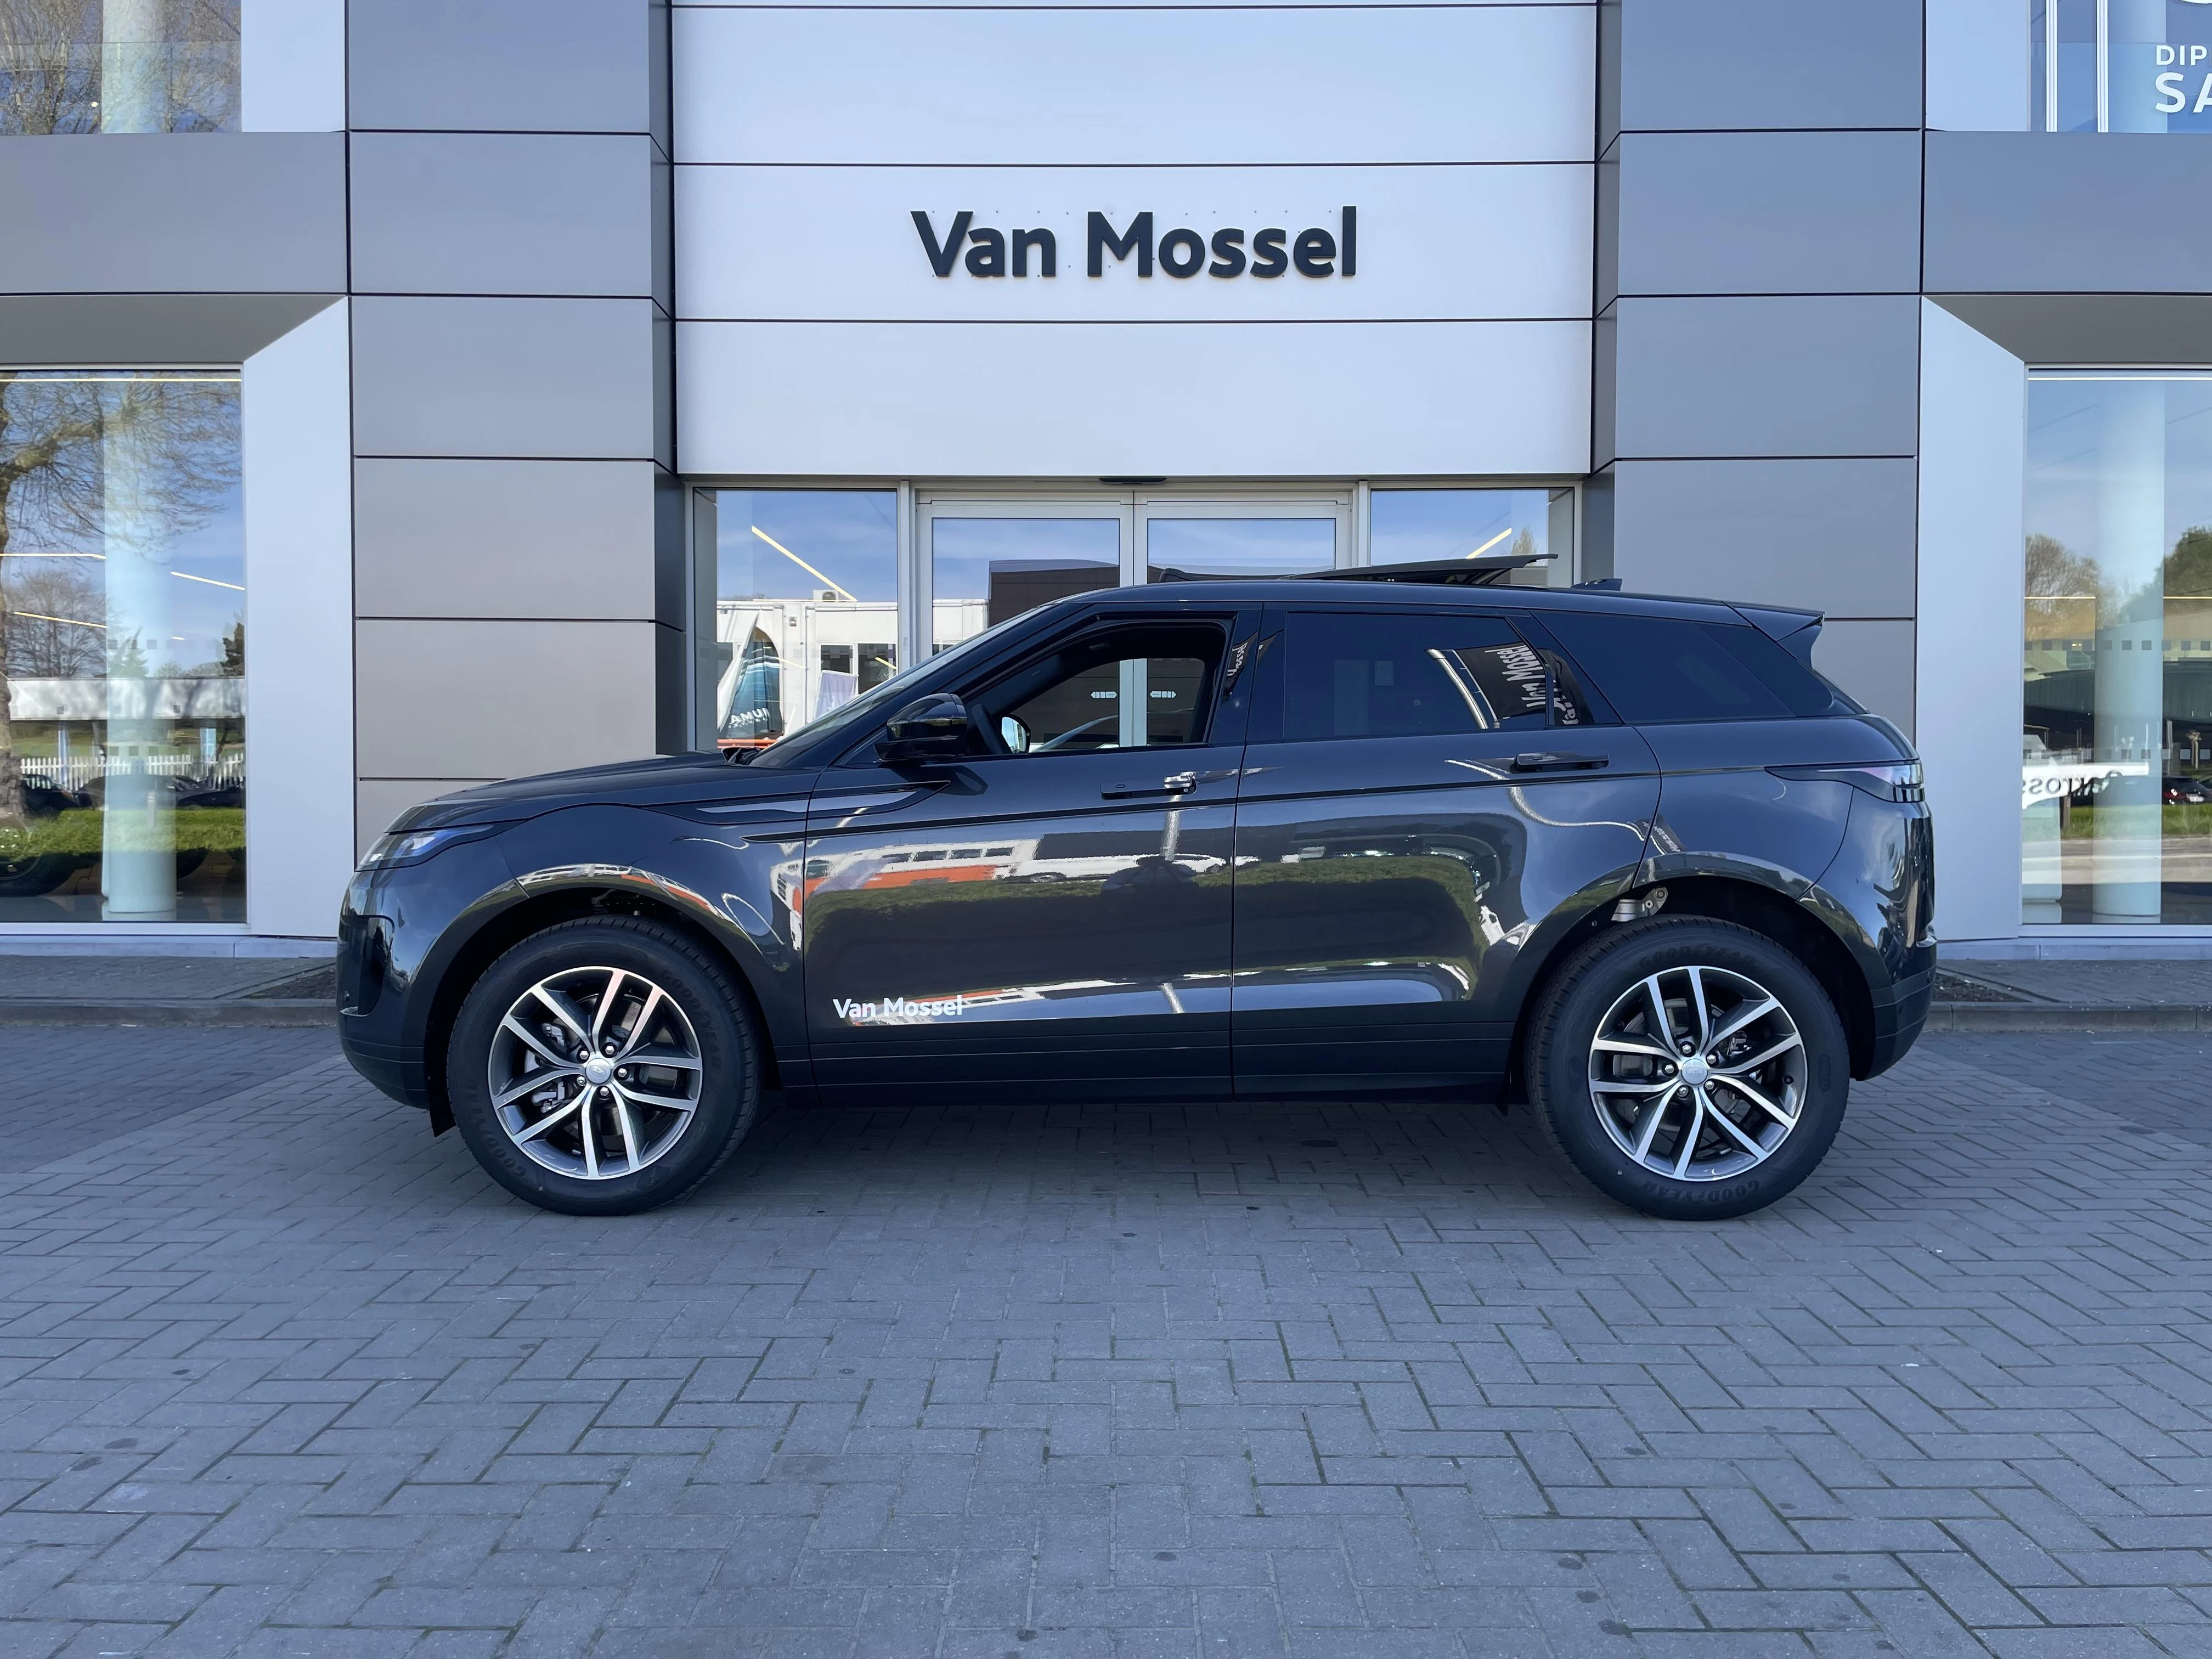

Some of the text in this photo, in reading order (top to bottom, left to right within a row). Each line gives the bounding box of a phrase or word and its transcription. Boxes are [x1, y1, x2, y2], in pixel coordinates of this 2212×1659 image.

[2156, 45, 2207, 66] DIP
[910, 206, 1358, 279] Van Mossel
[832, 994, 963, 1018] Van Mossel
